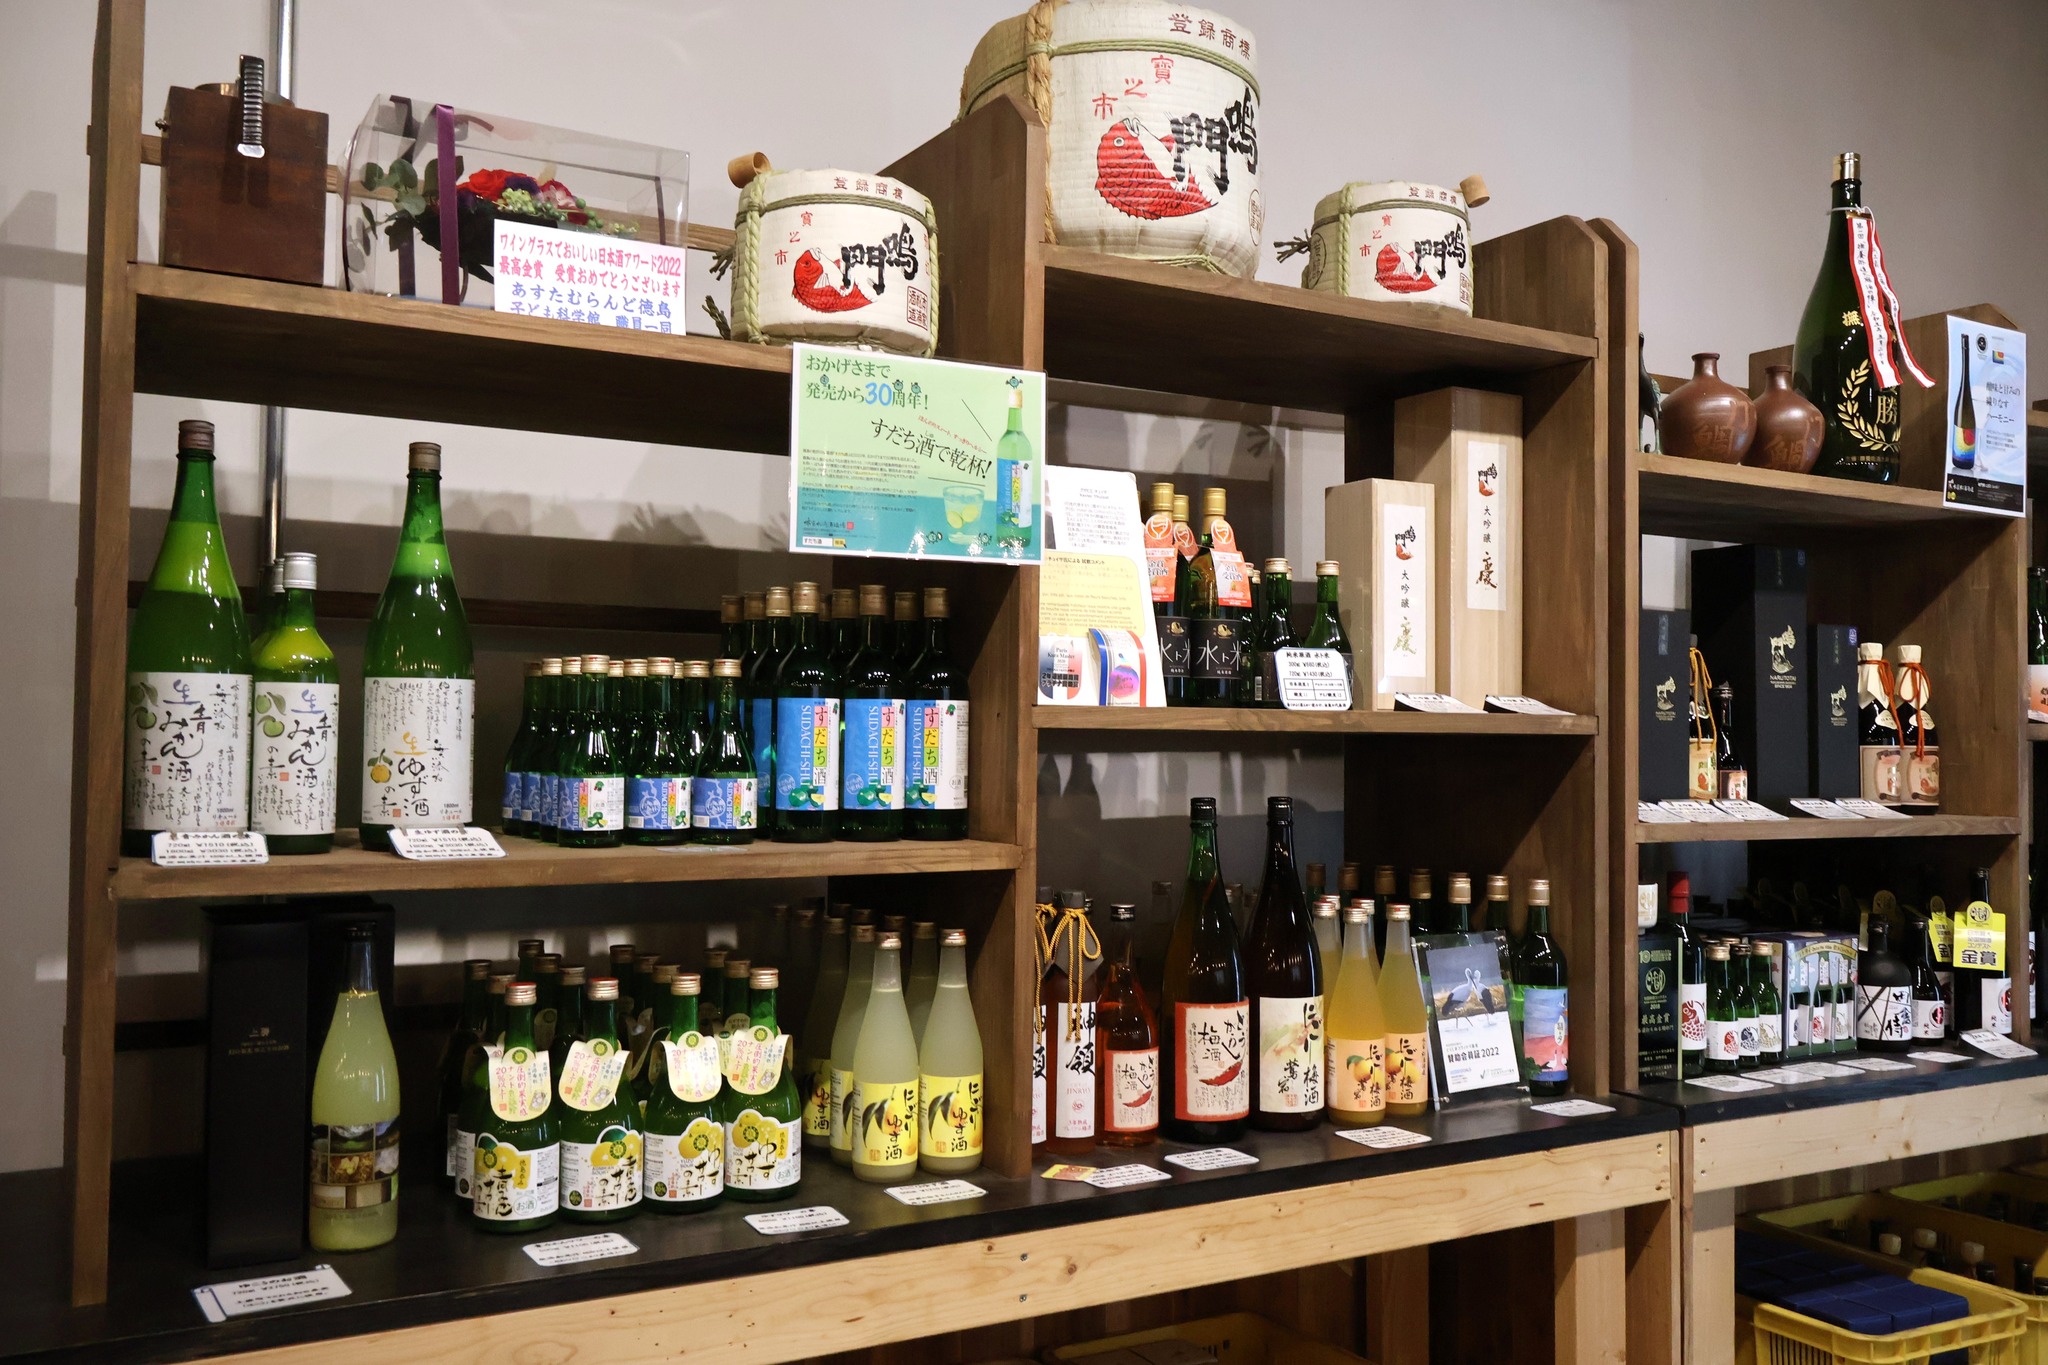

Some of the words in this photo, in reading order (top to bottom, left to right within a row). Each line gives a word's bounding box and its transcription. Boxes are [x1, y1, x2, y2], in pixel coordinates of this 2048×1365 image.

[498, 255, 544, 280] 最高金賞
[554, 263, 681, 298] 受賞おめでとうございます
[510, 281, 672, 318] あすたむらんど徳島
[805, 354, 891, 379] おかげさまで
[814, 707, 828, 785] すだち酒
[881, 707, 895, 785] すだち酒
[924, 708, 938, 785] すだち酒
[1197, 1021, 1221, 1062] 梅酒
[1481, 1046, 1500, 1058] 2022
[1303, 1064, 1320, 1107] 梅酒
[1369, 1081, 1381, 1108] 梅酒
[1399, 1075, 1414, 1101] 梅酒
